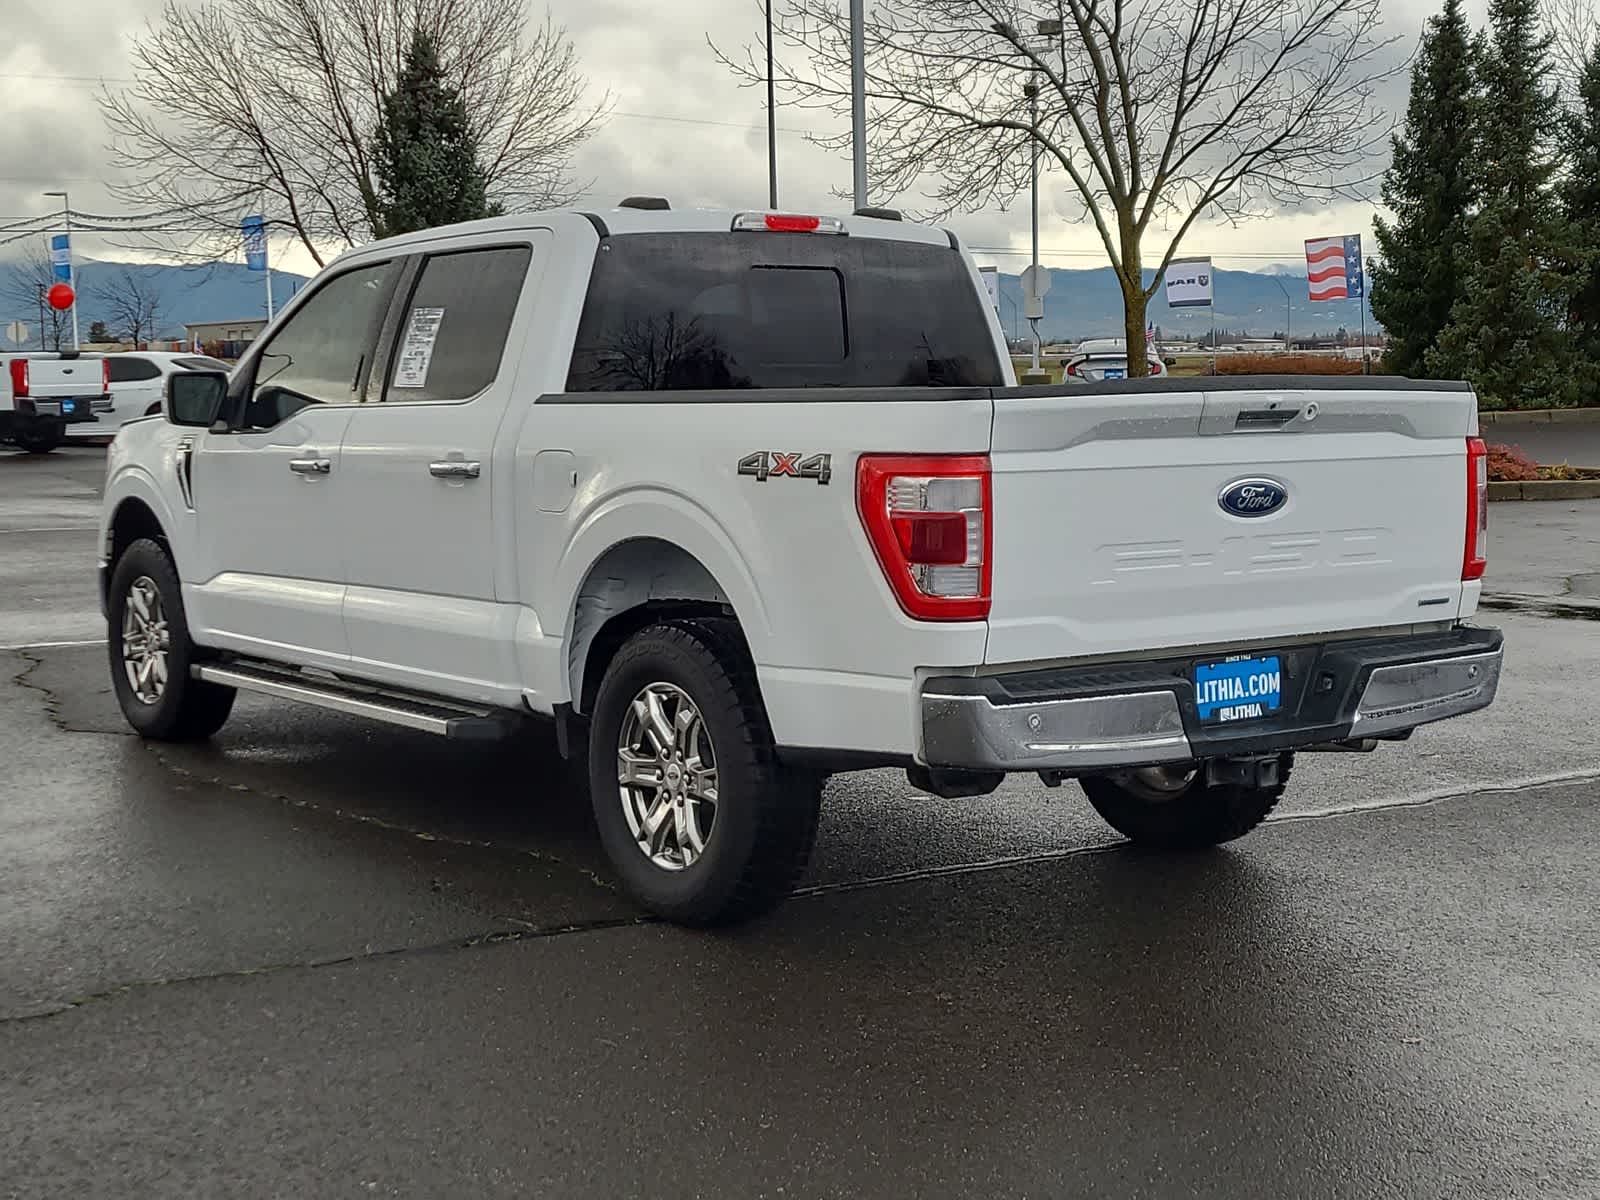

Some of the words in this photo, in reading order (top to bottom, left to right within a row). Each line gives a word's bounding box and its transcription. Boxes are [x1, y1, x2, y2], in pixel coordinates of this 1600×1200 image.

[1237, 486, 1275, 509] Ford
[1196, 671, 1280, 704] LITHIA.COM
[1230, 703, 1263, 720] LITHIA
